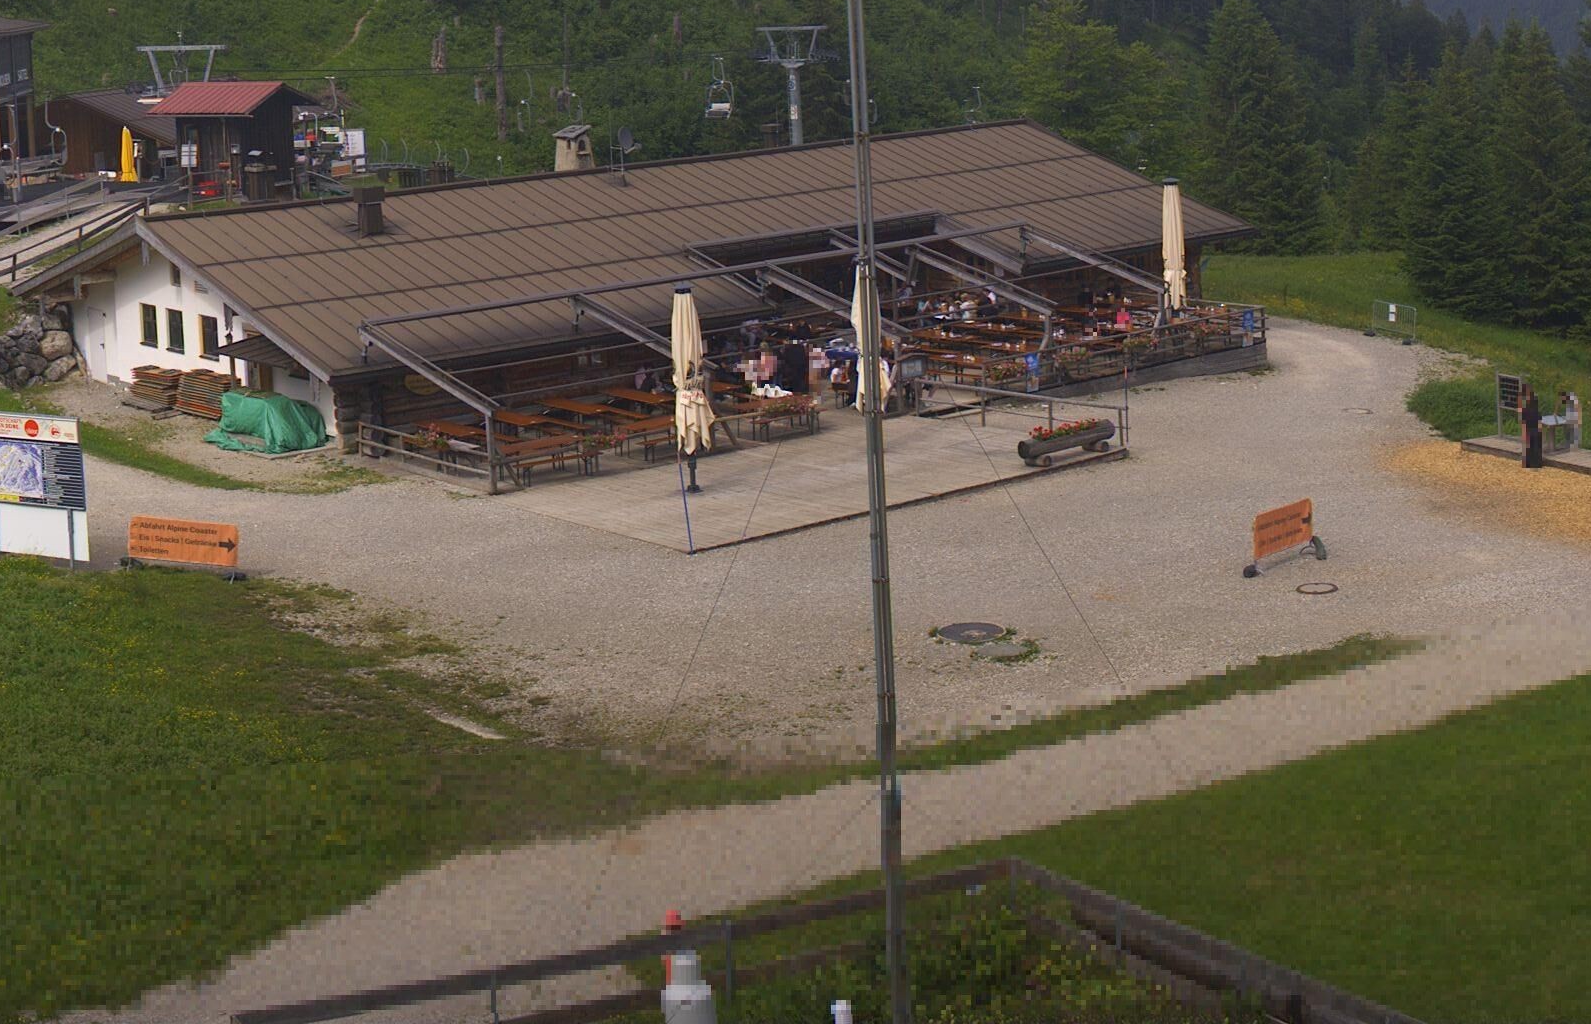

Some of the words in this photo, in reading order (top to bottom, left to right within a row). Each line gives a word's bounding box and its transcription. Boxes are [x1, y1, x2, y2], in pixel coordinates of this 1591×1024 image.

[139, 522, 165, 531] Abfahrt
[167, 524, 188, 533] Alpine
[190, 526, 218, 535] Coaster
[154, 535, 179, 544] Snacks
[139, 545, 169, 555] Toiletten
